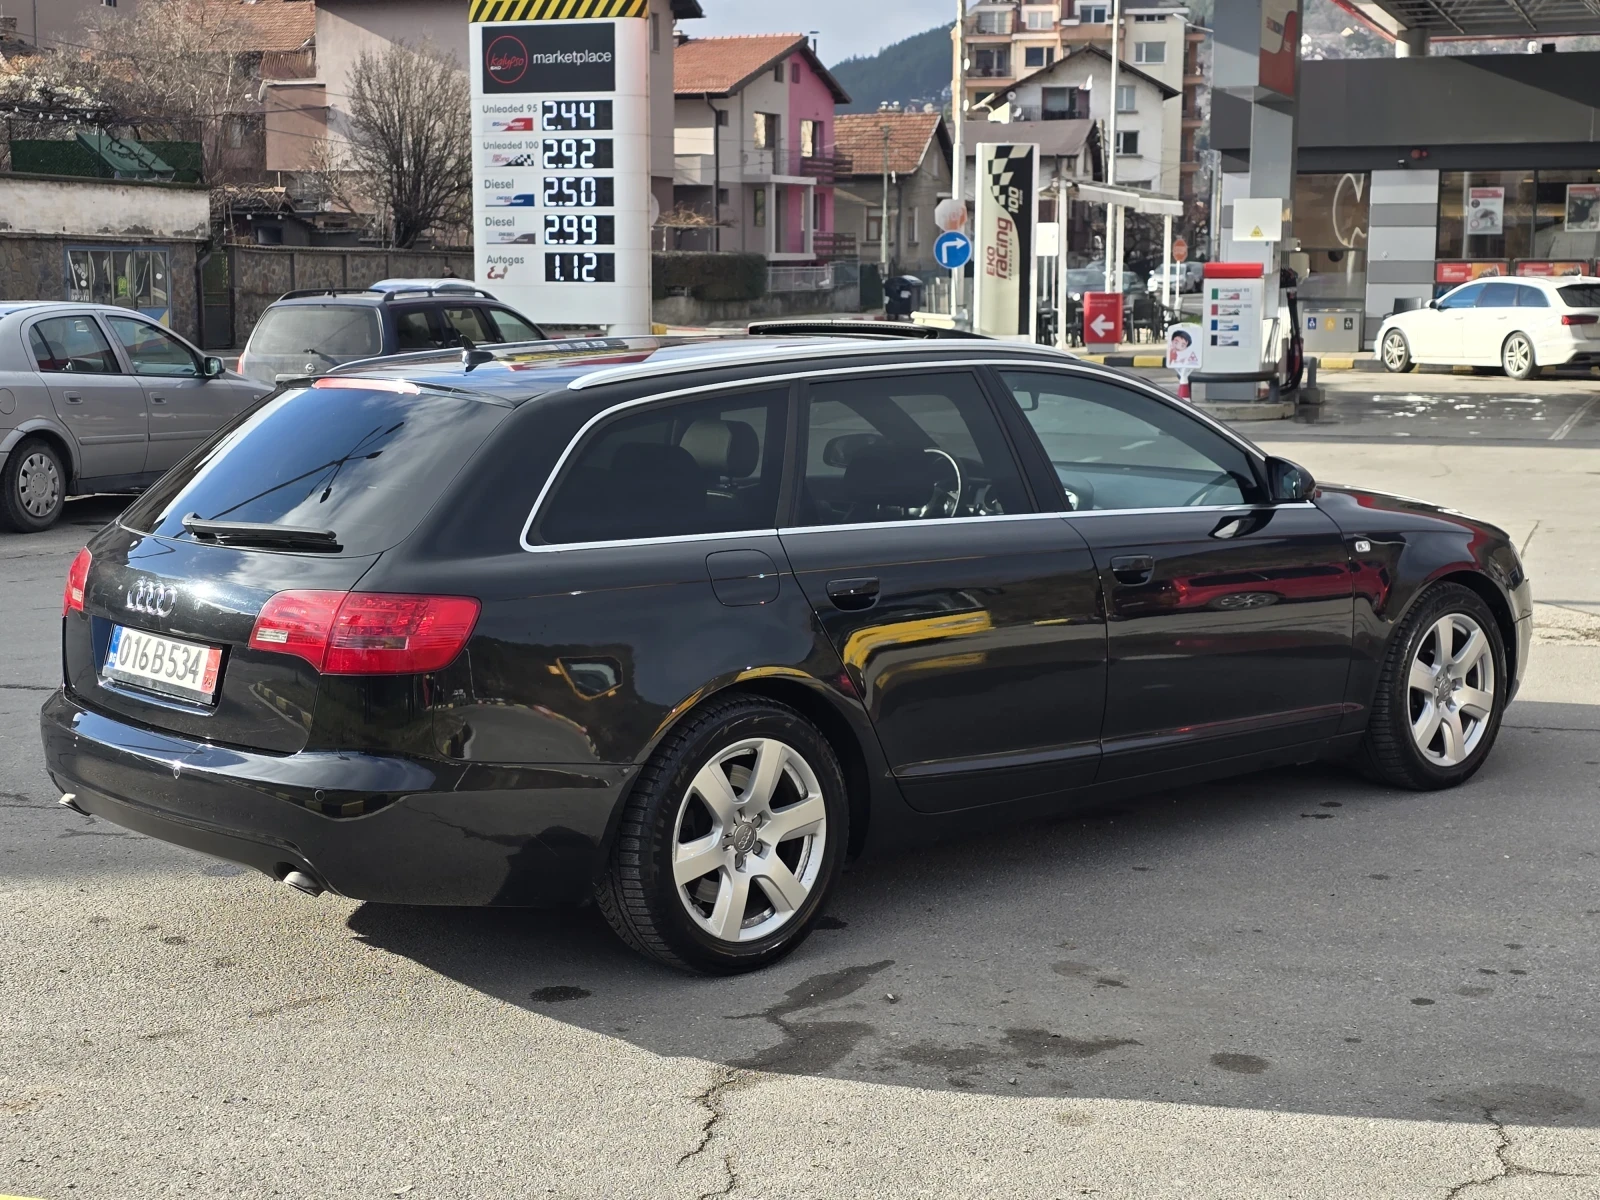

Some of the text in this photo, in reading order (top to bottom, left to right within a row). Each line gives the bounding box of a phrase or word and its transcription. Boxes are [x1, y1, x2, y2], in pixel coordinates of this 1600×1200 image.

[533, 49, 612, 66] marketplace
[482, 104, 538, 113] Unleaded 95
[542, 101, 595, 130] 2.44
[483, 141, 539, 150] Unleaded 100
[543, 139, 596, 169] 2.92
[484, 179, 514, 189] Diesel
[544, 177, 597, 206] 2.50
[1008, 186, 1019, 214] 100
[485, 216, 515, 227] Diesel
[545, 215, 597, 245] 2.99
[486, 254, 525, 266] Autogas
[986, 245, 996, 277] EKO
[996, 216, 1013, 280] racing
[554, 253, 597, 281] 1.12
[119, 633, 203, 684] 016B534
